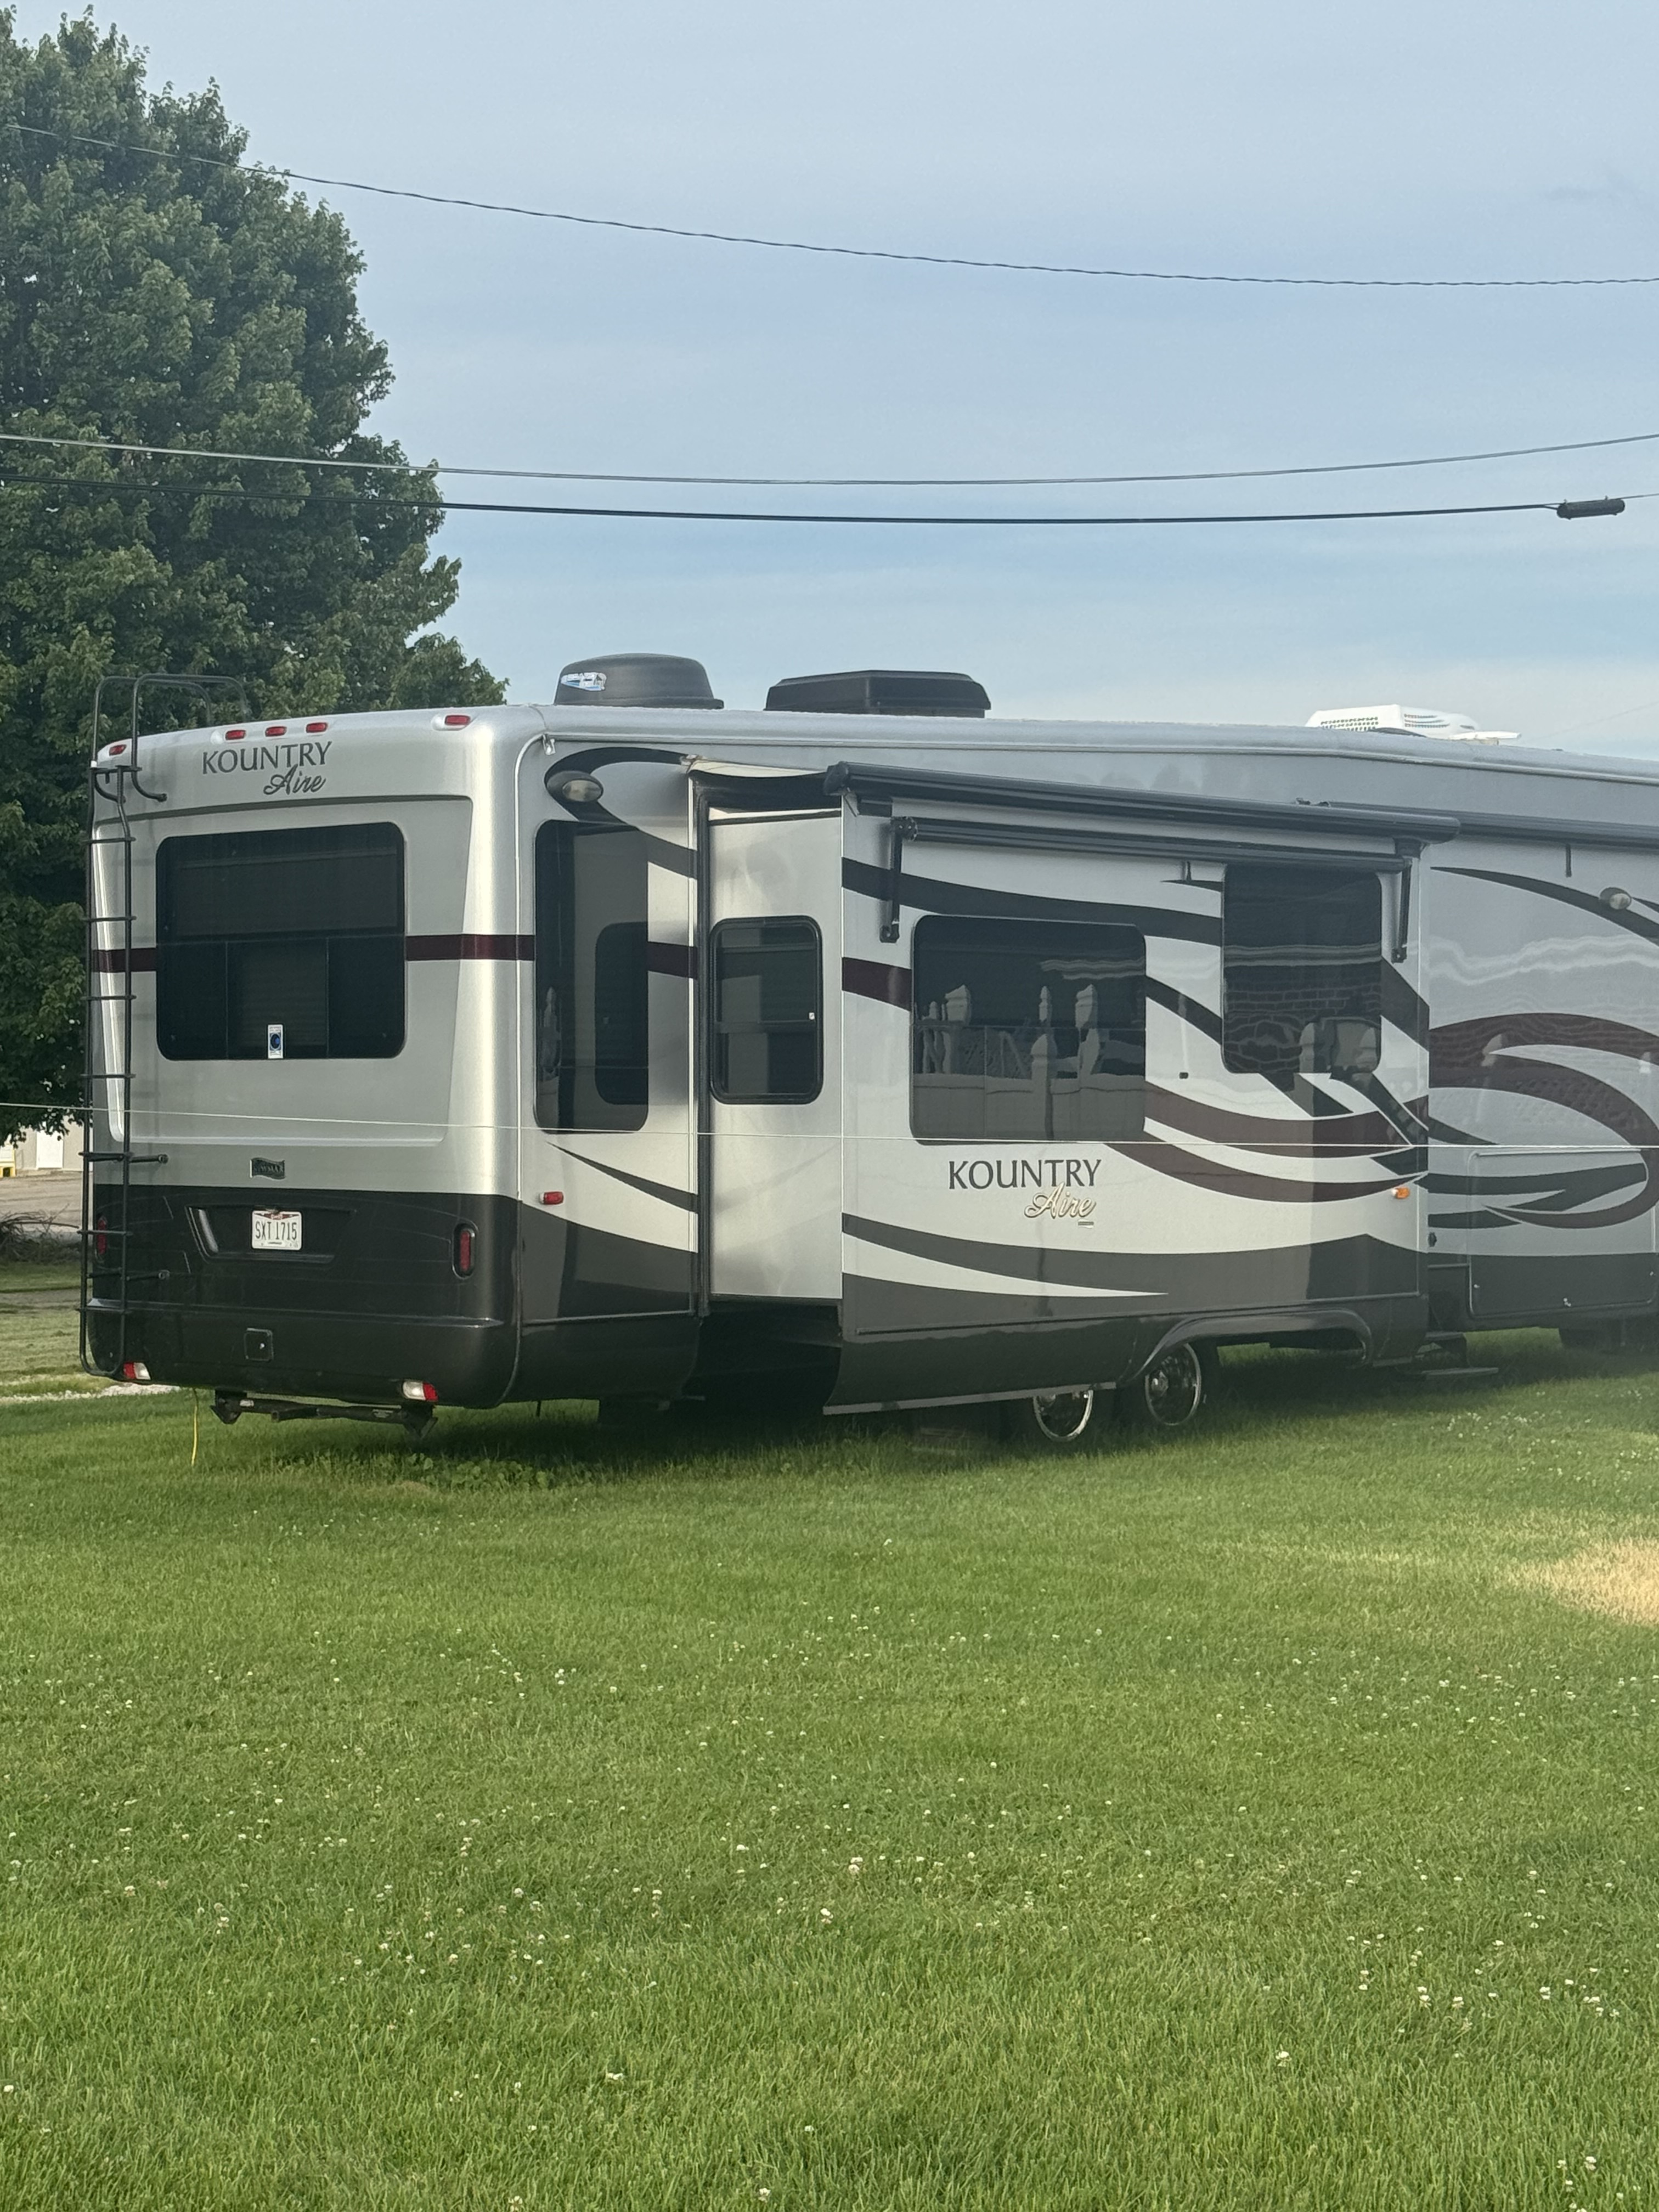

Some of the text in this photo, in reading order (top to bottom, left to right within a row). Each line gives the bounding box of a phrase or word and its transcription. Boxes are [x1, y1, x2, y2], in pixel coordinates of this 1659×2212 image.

[202, 741, 332, 775] KOUNTRY
[263, 763, 326, 795] Aire
[949, 1159, 1102, 1190] KOUNTRY
[1024, 1182, 1097, 1219] Aire
[255, 1221, 297, 1241] SXT 1715
